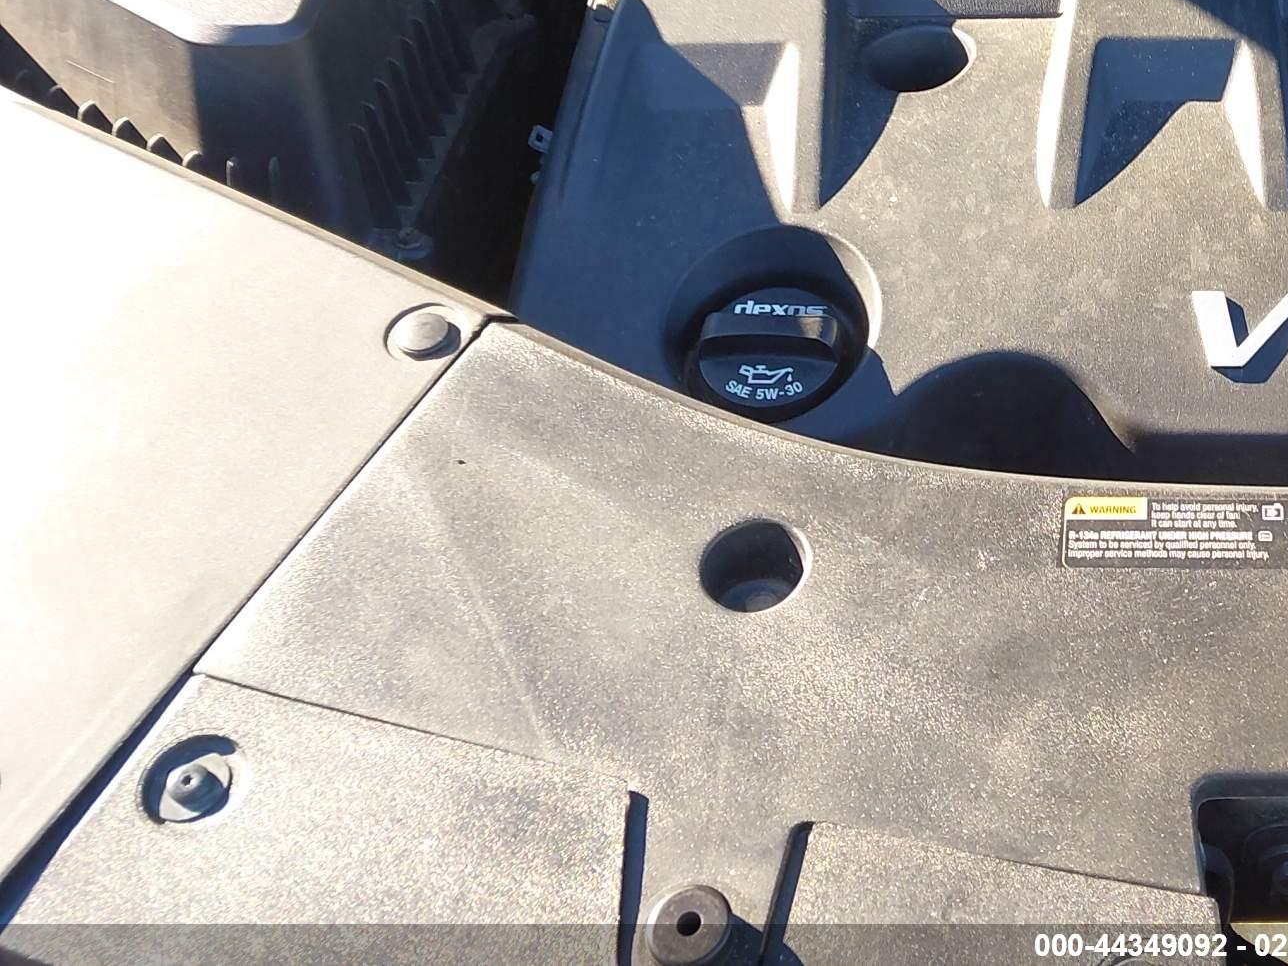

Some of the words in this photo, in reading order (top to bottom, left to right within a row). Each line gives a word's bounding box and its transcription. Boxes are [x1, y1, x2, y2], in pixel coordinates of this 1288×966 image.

[725, 381, 752, 399] SAE
[755, 381, 803, 400] 5W-30
[1090, 506, 1136, 514] WARNING
[1152, 503, 1160, 511] To
[1162, 503, 1178, 512] help
[1180, 503, 1198, 511] avoid
[1200, 503, 1234, 512] personal
[1152, 512, 1169, 520] keep
[1174, 520, 1191, 528] start
[1204, 521, 1217, 529] any
[1068, 541, 1097, 550] System
[1120, 541, 1152, 549] serviced
[1154, 541, 1164, 550] by
[1166, 541, 1198, 550] qualified
[1200, 541, 1237, 550] personnel
[1068, 550, 1103, 559] Improper
[1105, 550, 1132, 558] service
[1134, 550, 1168, 558] methods
[1169, 551, 1186, 559] may
[1212, 550, 1245, 559] personal
